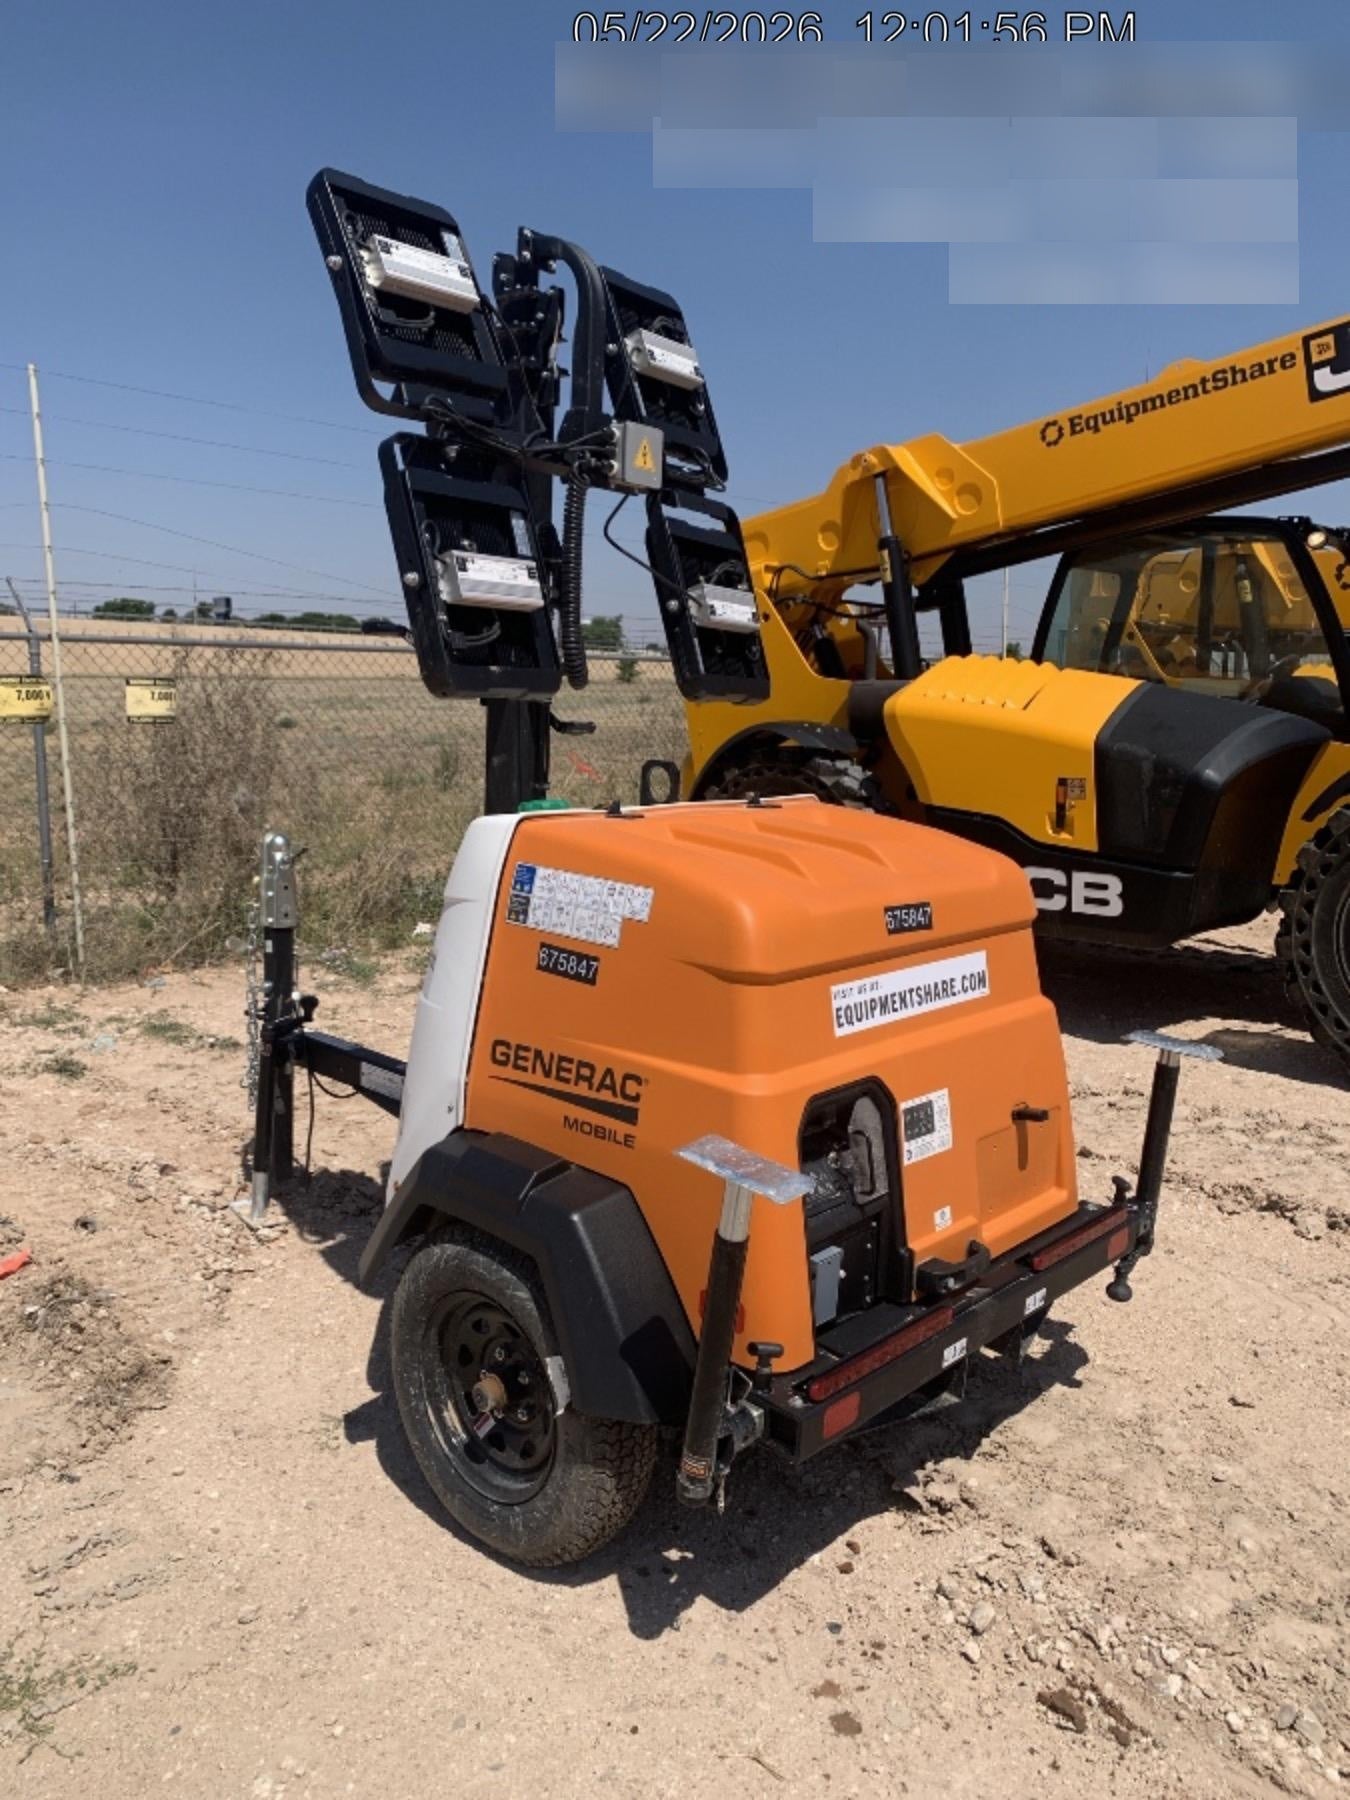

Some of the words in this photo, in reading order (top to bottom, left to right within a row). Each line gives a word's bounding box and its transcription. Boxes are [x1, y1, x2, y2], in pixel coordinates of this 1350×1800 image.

[1068, 350, 1298, 437] EquipmentShare
[885, 906, 931, 929] 675847
[539, 947, 599, 980] 675847
[835, 969, 987, 1029] EQUIPMENTSHARE.COM
[490, 1039, 642, 1103] GENERAC
[563, 1115, 636, 1149] MOBILE
